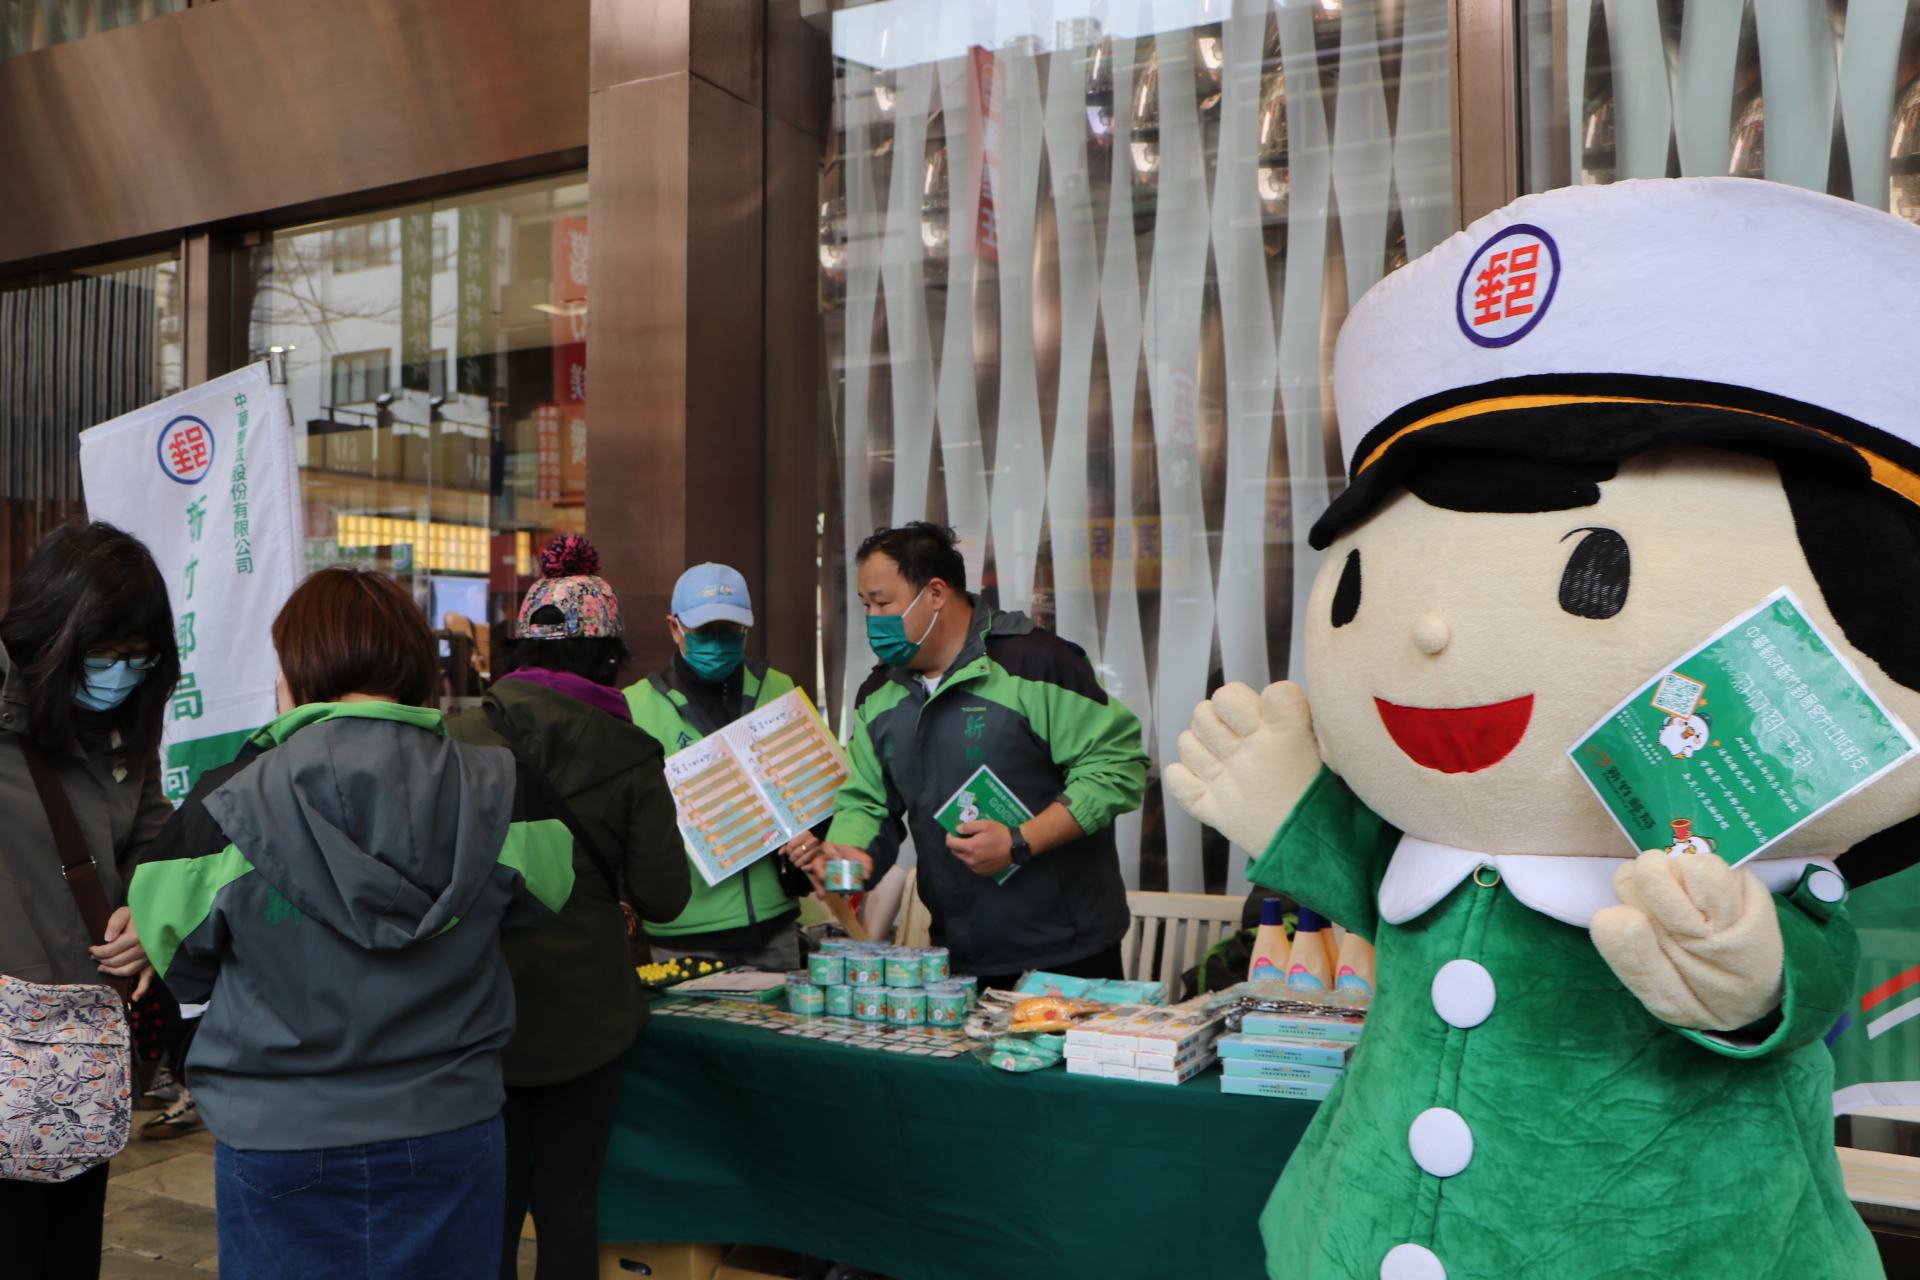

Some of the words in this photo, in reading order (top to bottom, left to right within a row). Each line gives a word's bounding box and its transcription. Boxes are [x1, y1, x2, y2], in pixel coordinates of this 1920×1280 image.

[1473, 243, 1541, 326] 郵
[168, 425, 208, 474] 郵
[1606, 765, 1656, 830] 新竹郵局
